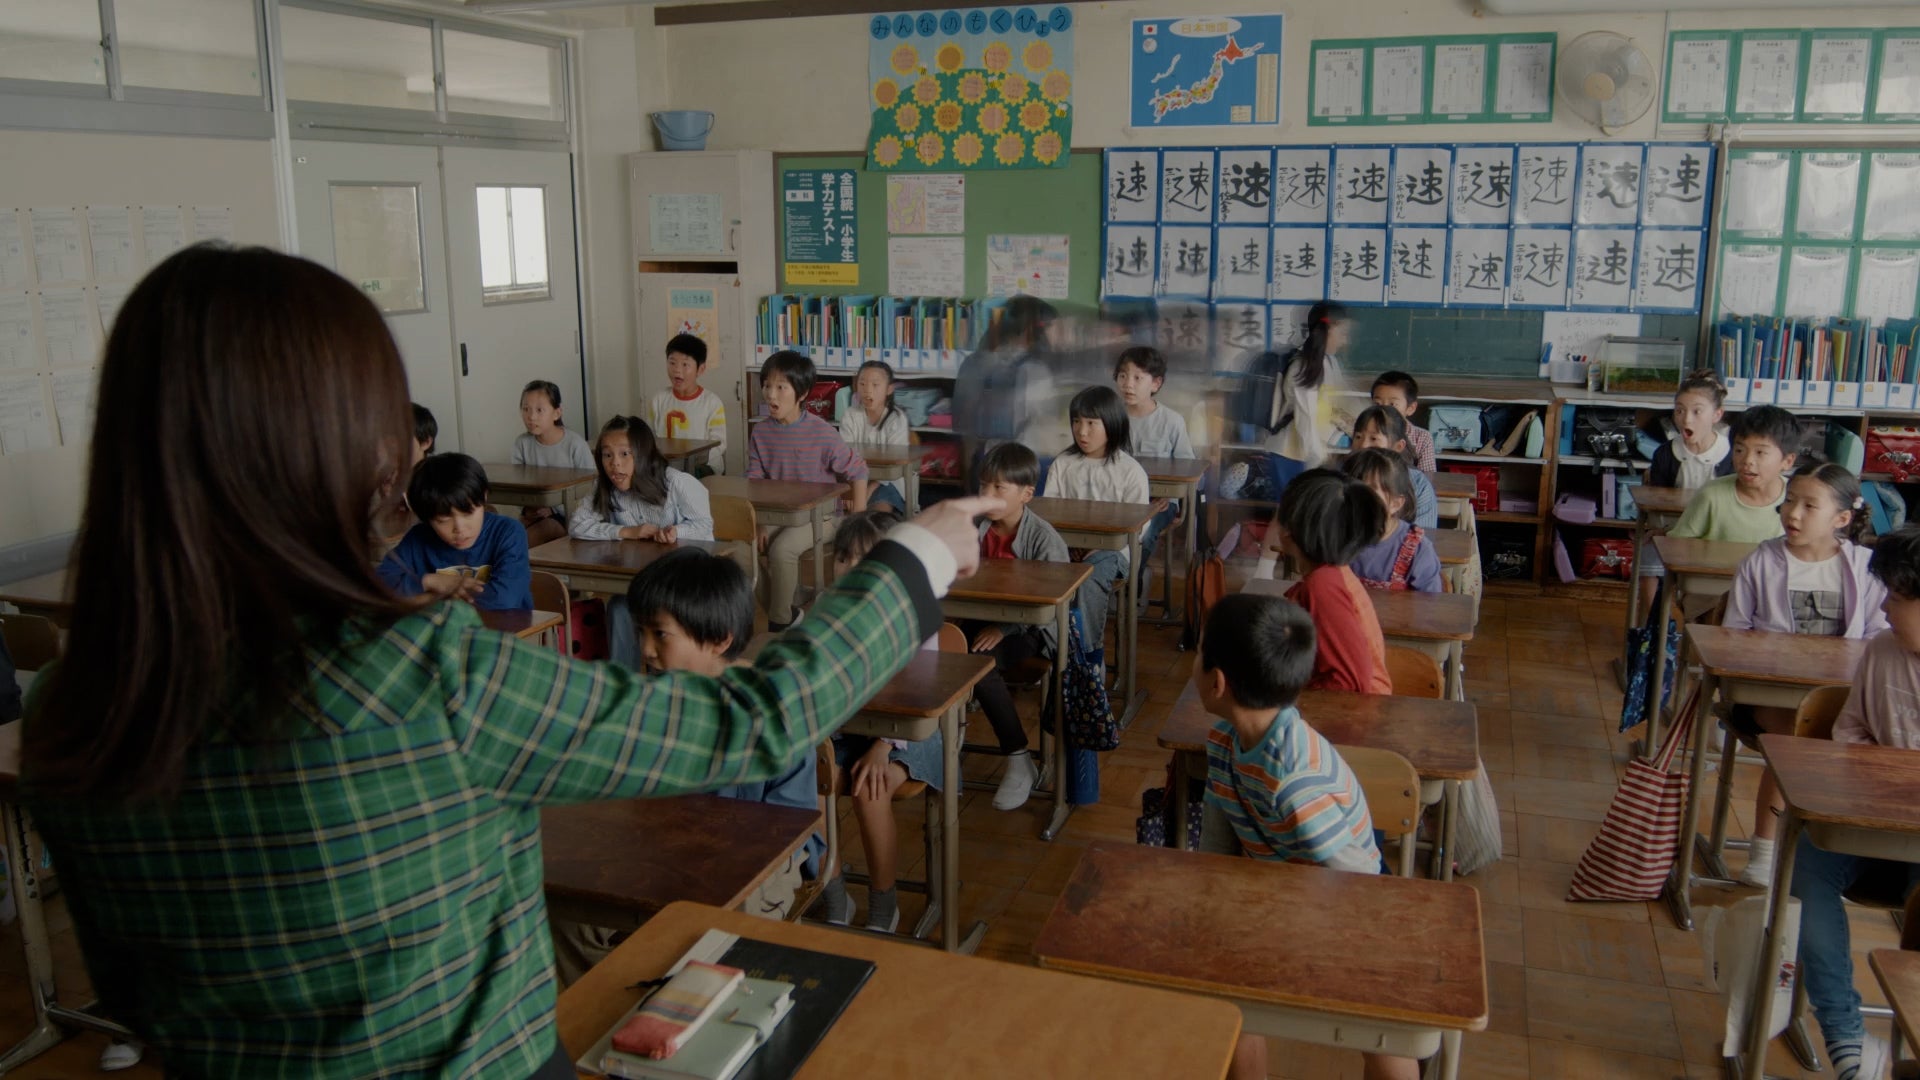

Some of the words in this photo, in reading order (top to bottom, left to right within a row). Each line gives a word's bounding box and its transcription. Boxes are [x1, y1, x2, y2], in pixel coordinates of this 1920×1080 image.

[873, 8, 1067, 36] みんなのもくひょう
[1116, 160, 1148, 202] 速
[1169, 161, 1209, 212] 速
[1230, 161, 1270, 207] 速
[1285, 161, 1326, 209] 速
[1347, 161, 1388, 202] 速
[1405, 160, 1444, 205] 速
[1464, 160, 1510, 208] 速
[1530, 155, 1568, 205] 速
[1597, 161, 1637, 208] 速
[1654, 153, 1702, 203] 速
[821, 172, 835, 246] 学力テスト
[840, 172, 855, 262] 全国統一小学生
[1115, 236, 1151, 278] 速
[1176, 238, 1209, 277] 速
[1231, 237, 1260, 275] 速
[1283, 242, 1319, 279] 速
[1342, 240, 1379, 281] 速
[1398, 238, 1435, 279] 速
[1465, 252, 1503, 291] 速
[1524, 242, 1564, 287] 速
[1585, 240, 1628, 285] 速
[1653, 243, 1695, 292] 速
